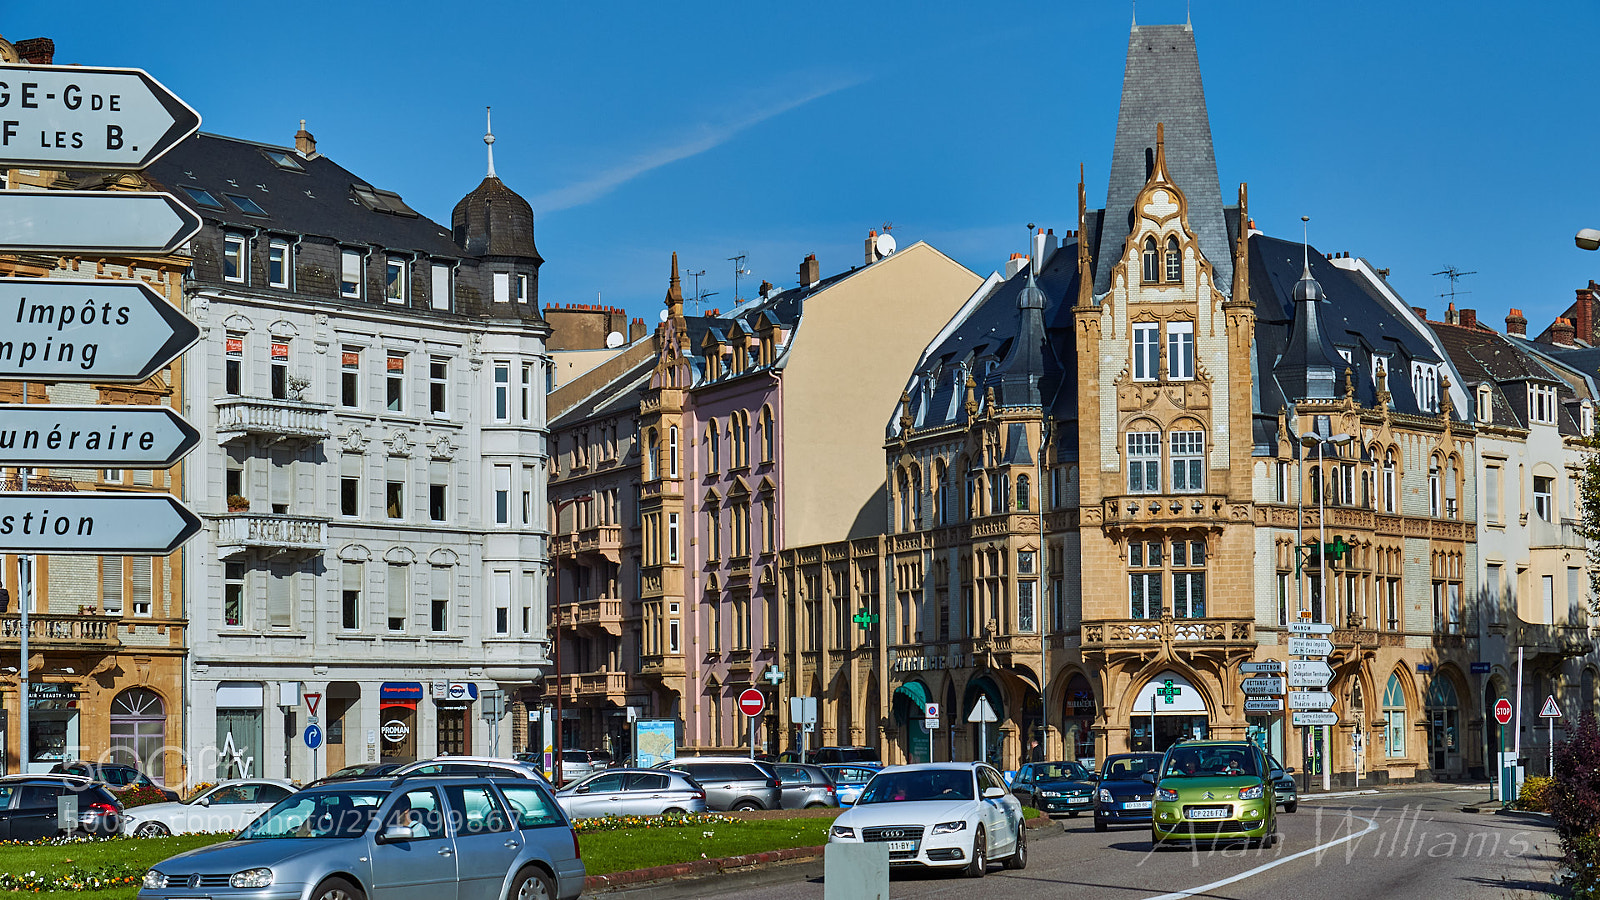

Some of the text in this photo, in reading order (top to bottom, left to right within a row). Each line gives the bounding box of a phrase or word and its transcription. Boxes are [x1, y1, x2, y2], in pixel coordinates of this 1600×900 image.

[40, 130, 84, 149] LES
[106, 124, 139, 152] B.
[16, 297, 130, 331] Impôts
[0, 509, 94, 536] stion
[1496, 707, 1511, 716] STOP
[381, 726, 410, 734] PROMAN
